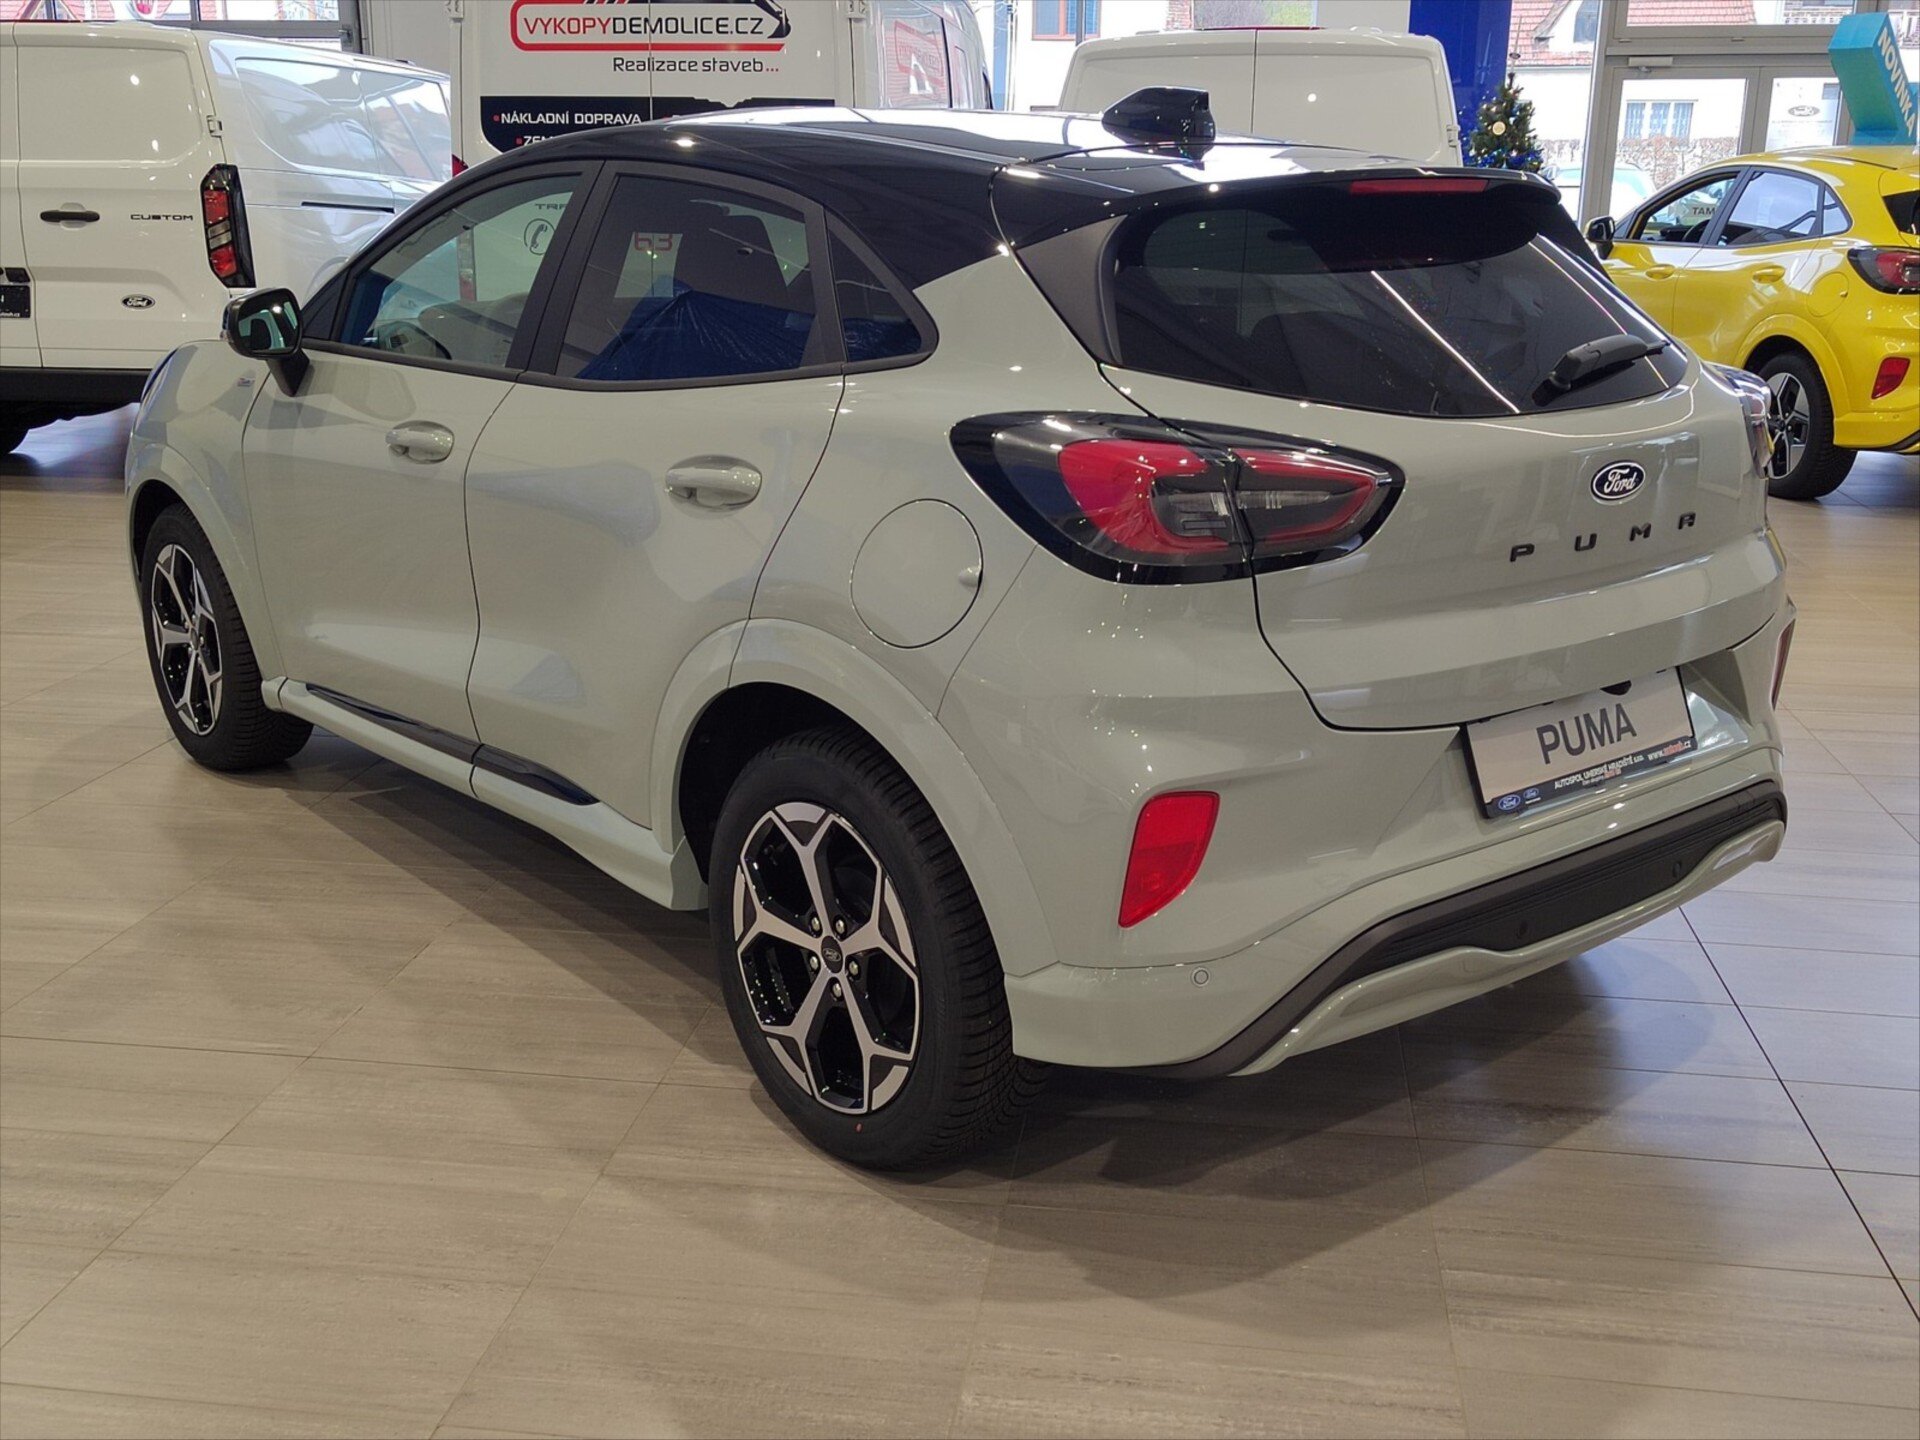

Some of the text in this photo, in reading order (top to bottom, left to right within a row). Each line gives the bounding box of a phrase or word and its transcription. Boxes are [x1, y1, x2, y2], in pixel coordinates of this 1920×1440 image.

[523, 17, 764, 35] VYKOPYDEMOLICE.CZ
[613, 57, 779, 73] Realizace staveb...
[1877, 26, 1916, 137] NOVINKA
[501, 110, 642, 125] NÁKLADNÍ DOPRAVA
[1536, 703, 1637, 764] PUMA
